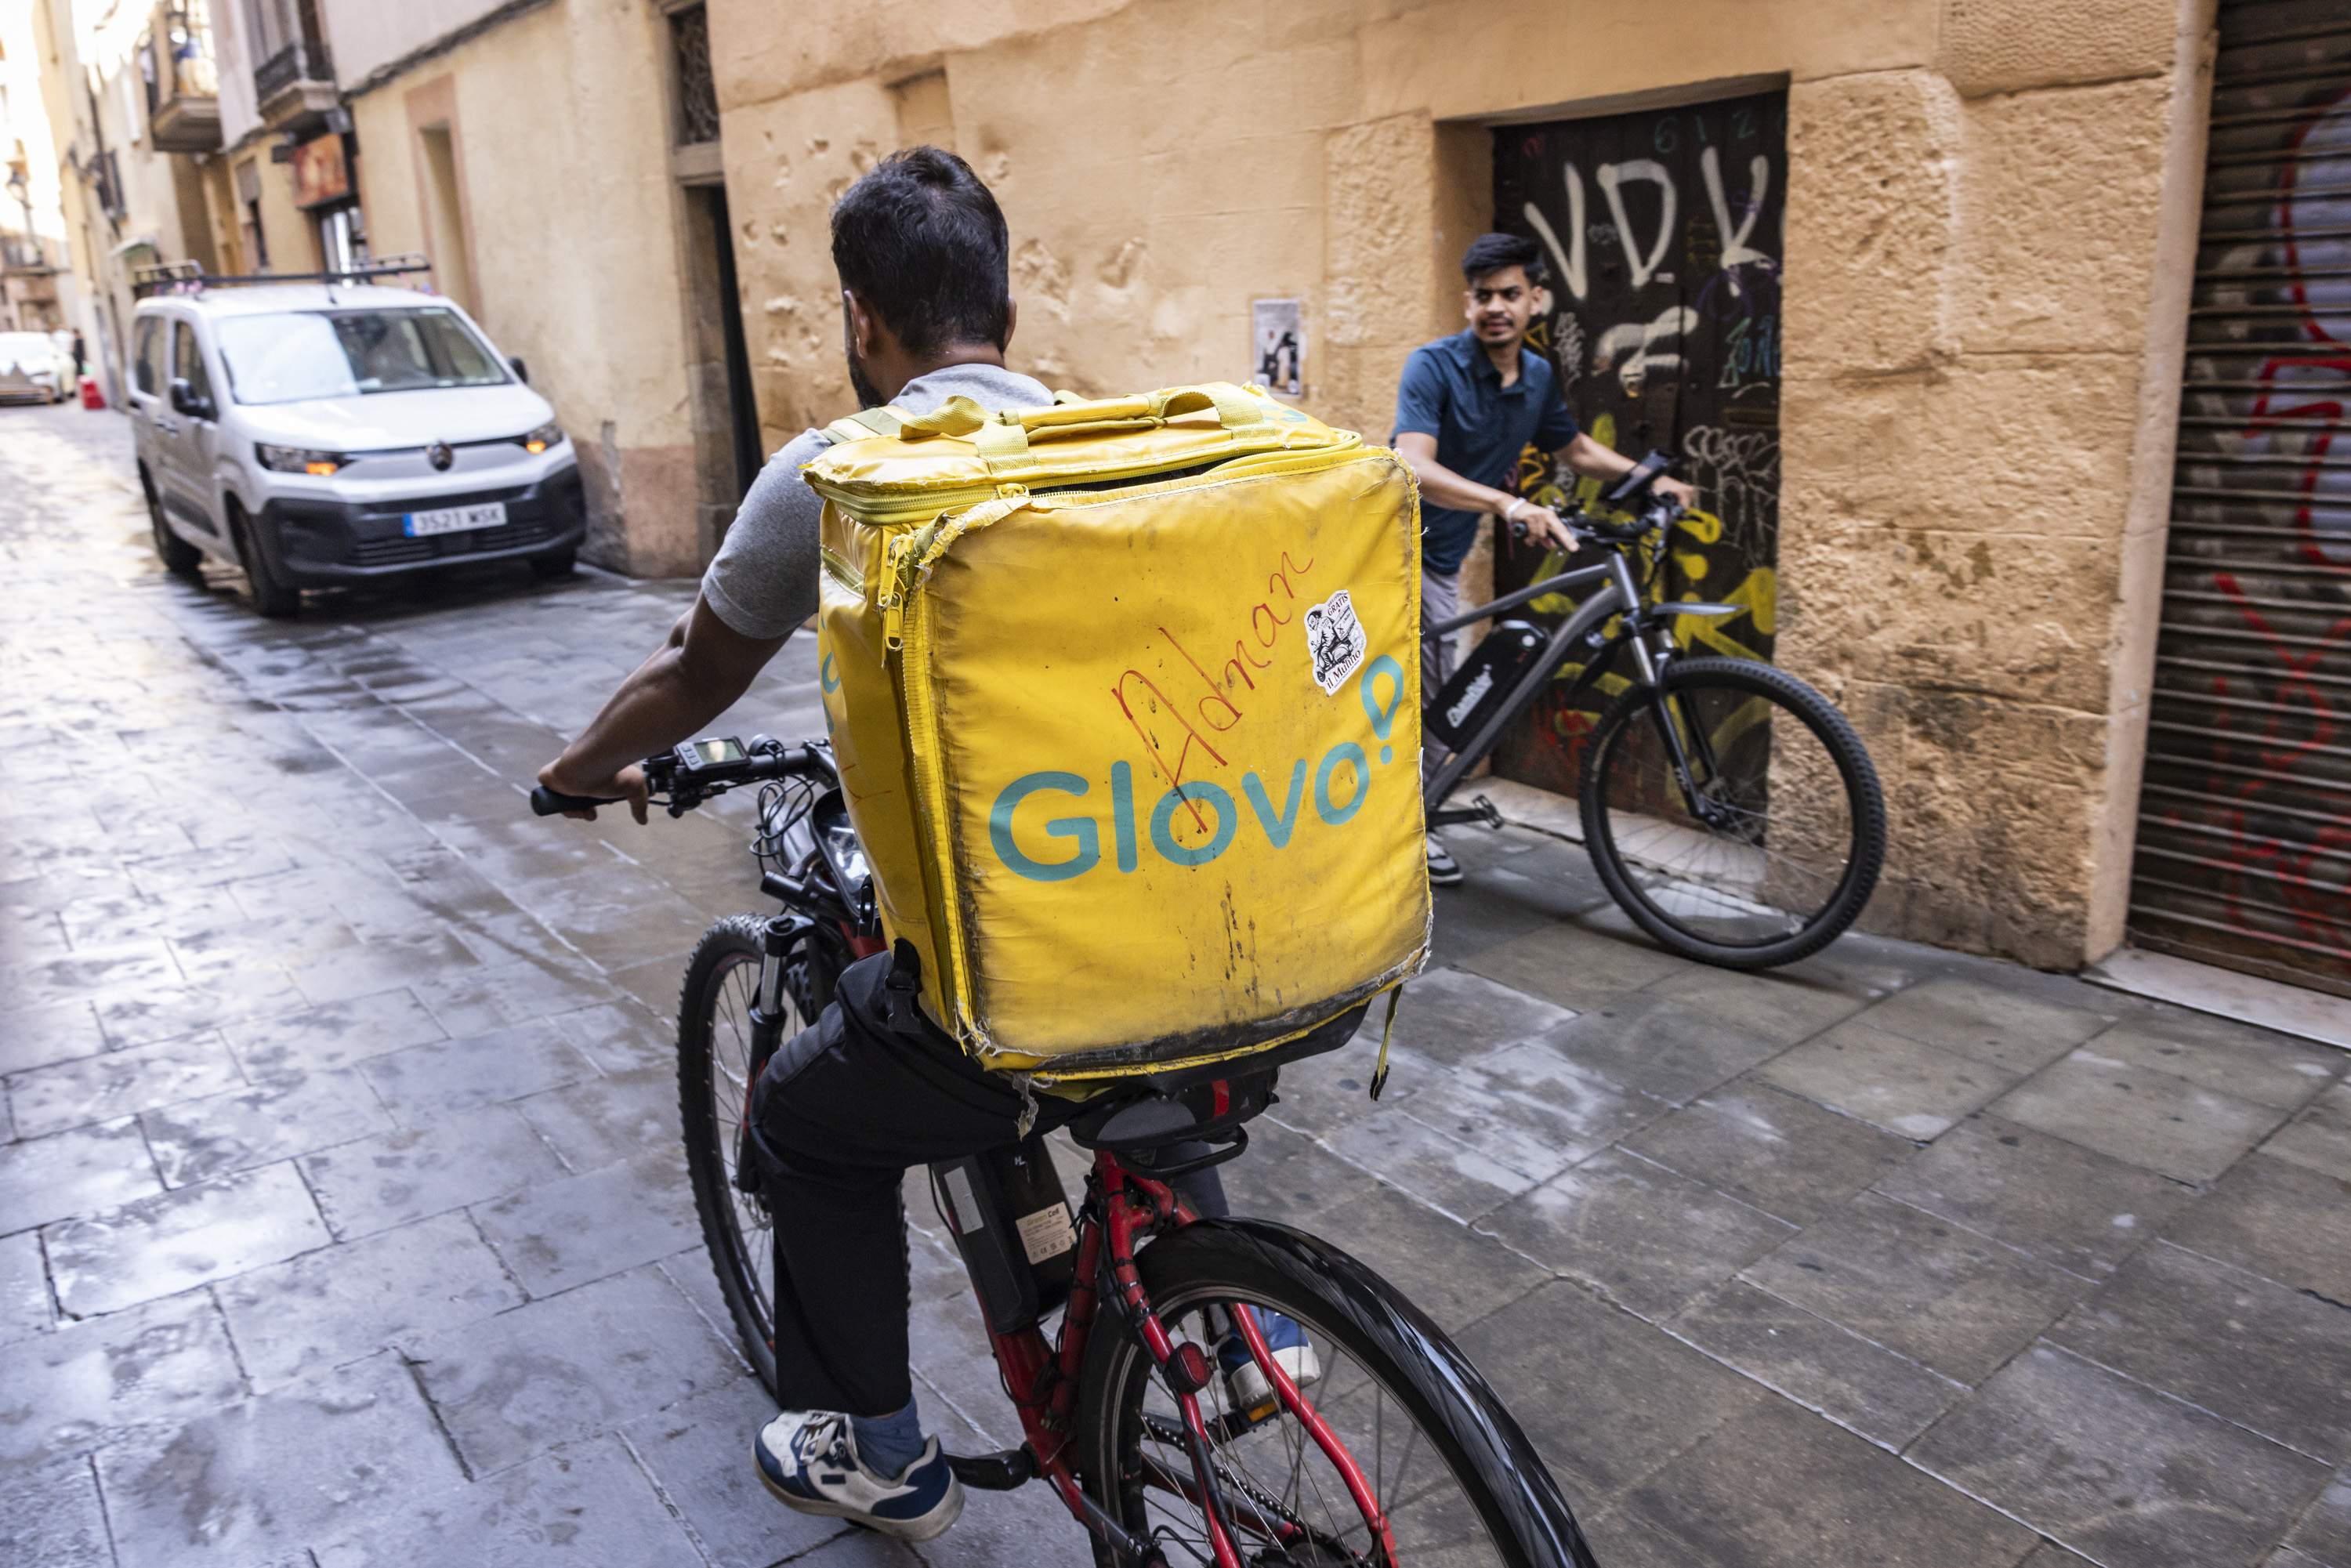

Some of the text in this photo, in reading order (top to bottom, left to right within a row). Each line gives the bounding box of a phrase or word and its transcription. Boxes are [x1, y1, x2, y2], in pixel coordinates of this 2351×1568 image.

[418, 511, 461, 531] 3521
[1328, 595, 1349, 617] GRATIS
[1111, 550, 1313, 832] Adnan
